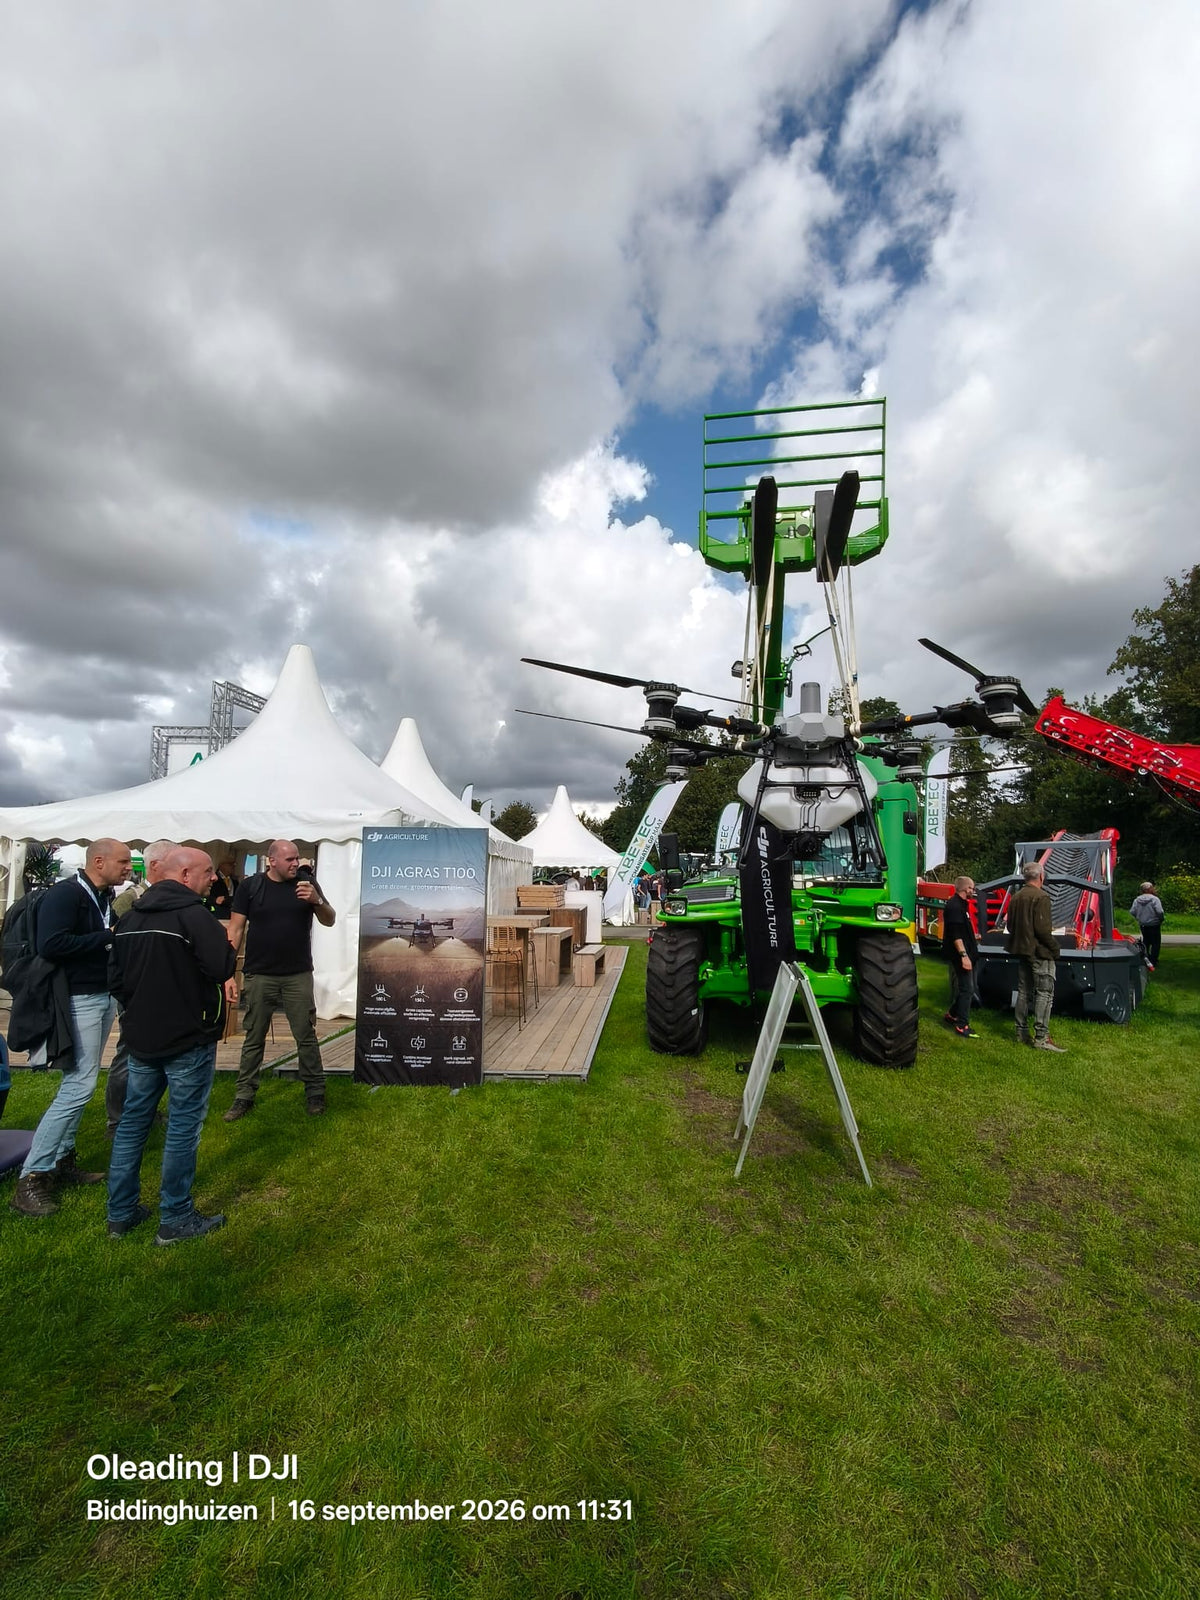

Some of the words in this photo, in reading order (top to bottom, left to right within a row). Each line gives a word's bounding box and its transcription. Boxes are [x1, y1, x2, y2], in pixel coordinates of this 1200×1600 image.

[384, 833, 429, 841] AGRICULTURE
[371, 866, 391, 878] DJI
[395, 866, 440, 879] AGRAS
[443, 867, 476, 879] T100
[758, 859, 778, 948] AGRICULTURE
